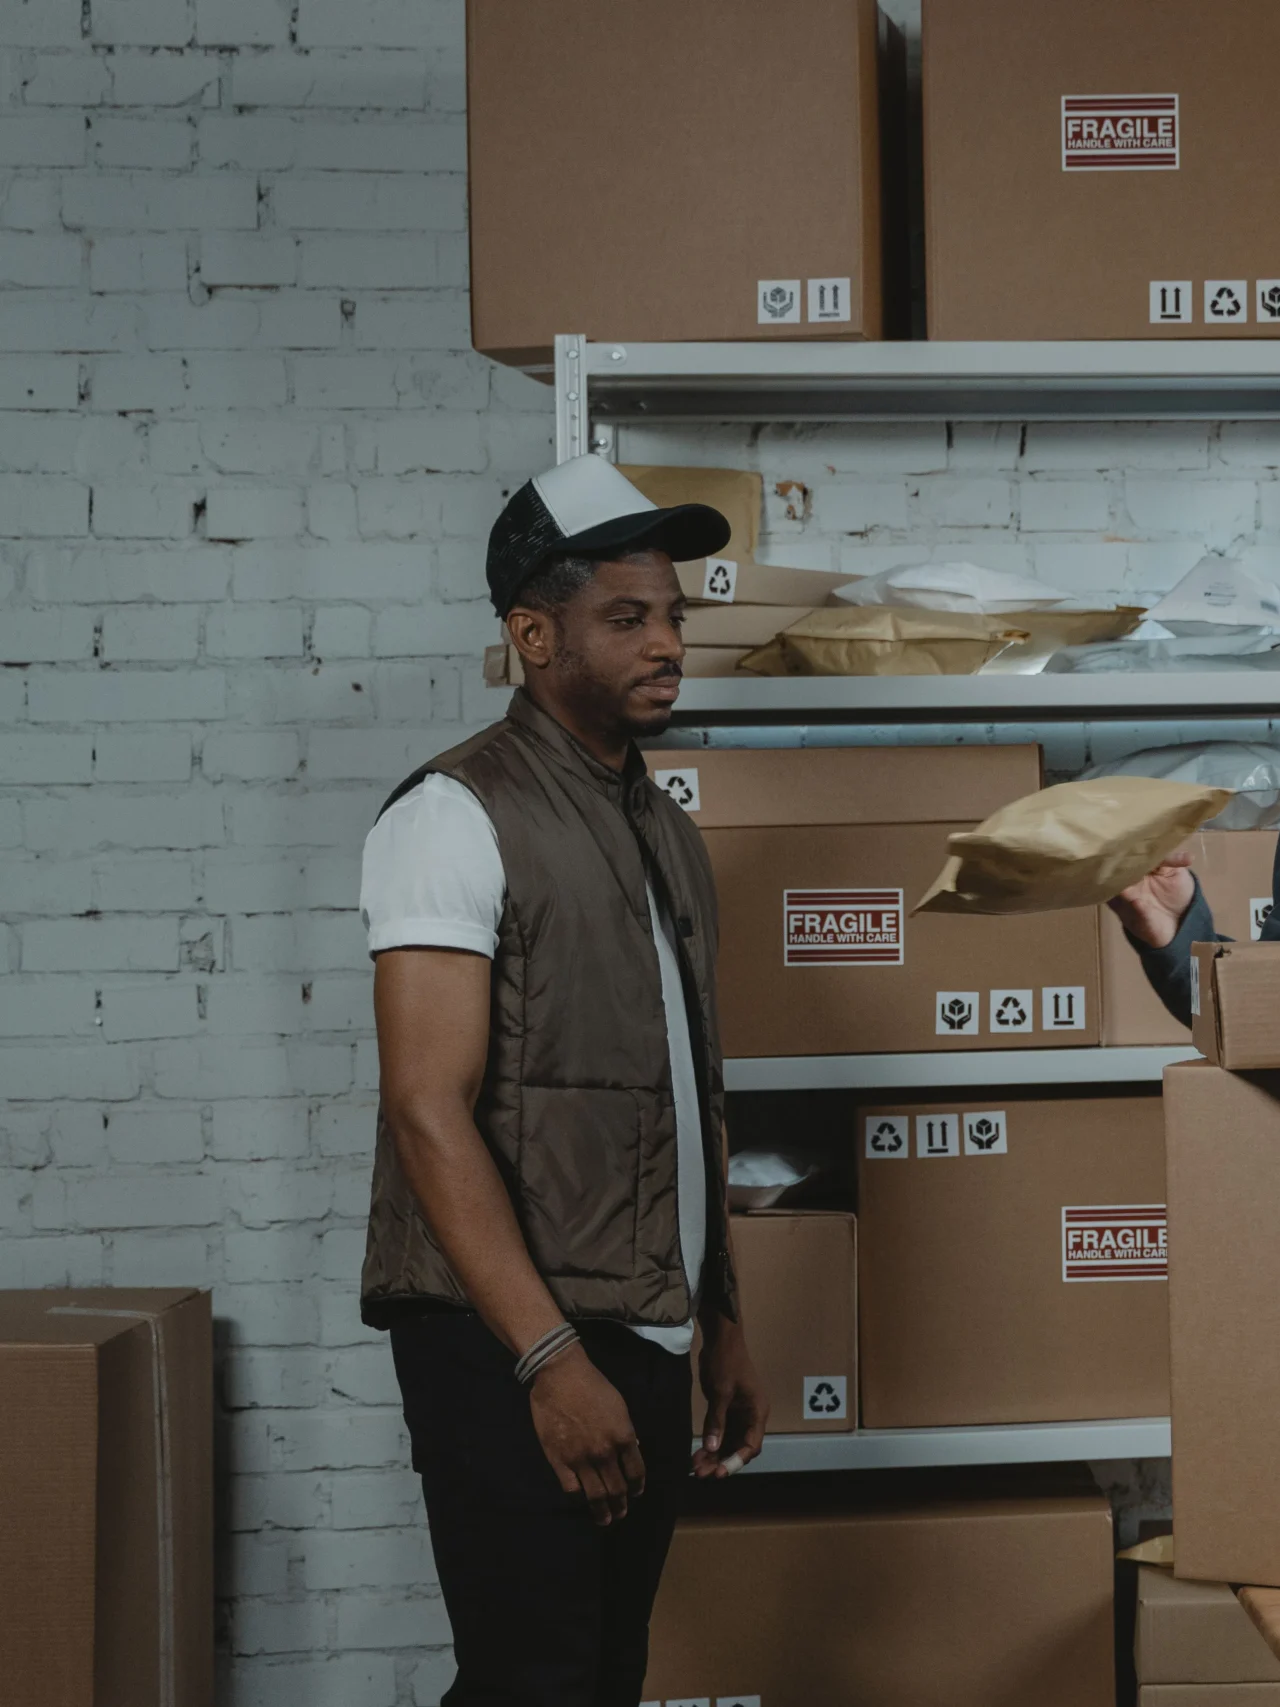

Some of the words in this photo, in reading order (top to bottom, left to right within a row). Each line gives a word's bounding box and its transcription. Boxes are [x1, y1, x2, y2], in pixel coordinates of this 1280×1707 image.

[1067, 117, 1173, 139] FRAGILE
[1067, 138, 1111, 149] HANDLE
[1113, 138, 1141, 148] WITH
[1143, 138, 1173, 148] CARE
[789, 912, 897, 933] FRAGILE
[789, 933, 834, 943] HANDLE
[836, 933, 864, 943] WITH
[866, 933, 897, 942] CARE
[1068, 1249, 1112, 1259] HANDLE
[1114, 1249, 1141, 1258] WITH
[1143, 1248, 1168, 1258] CAR
